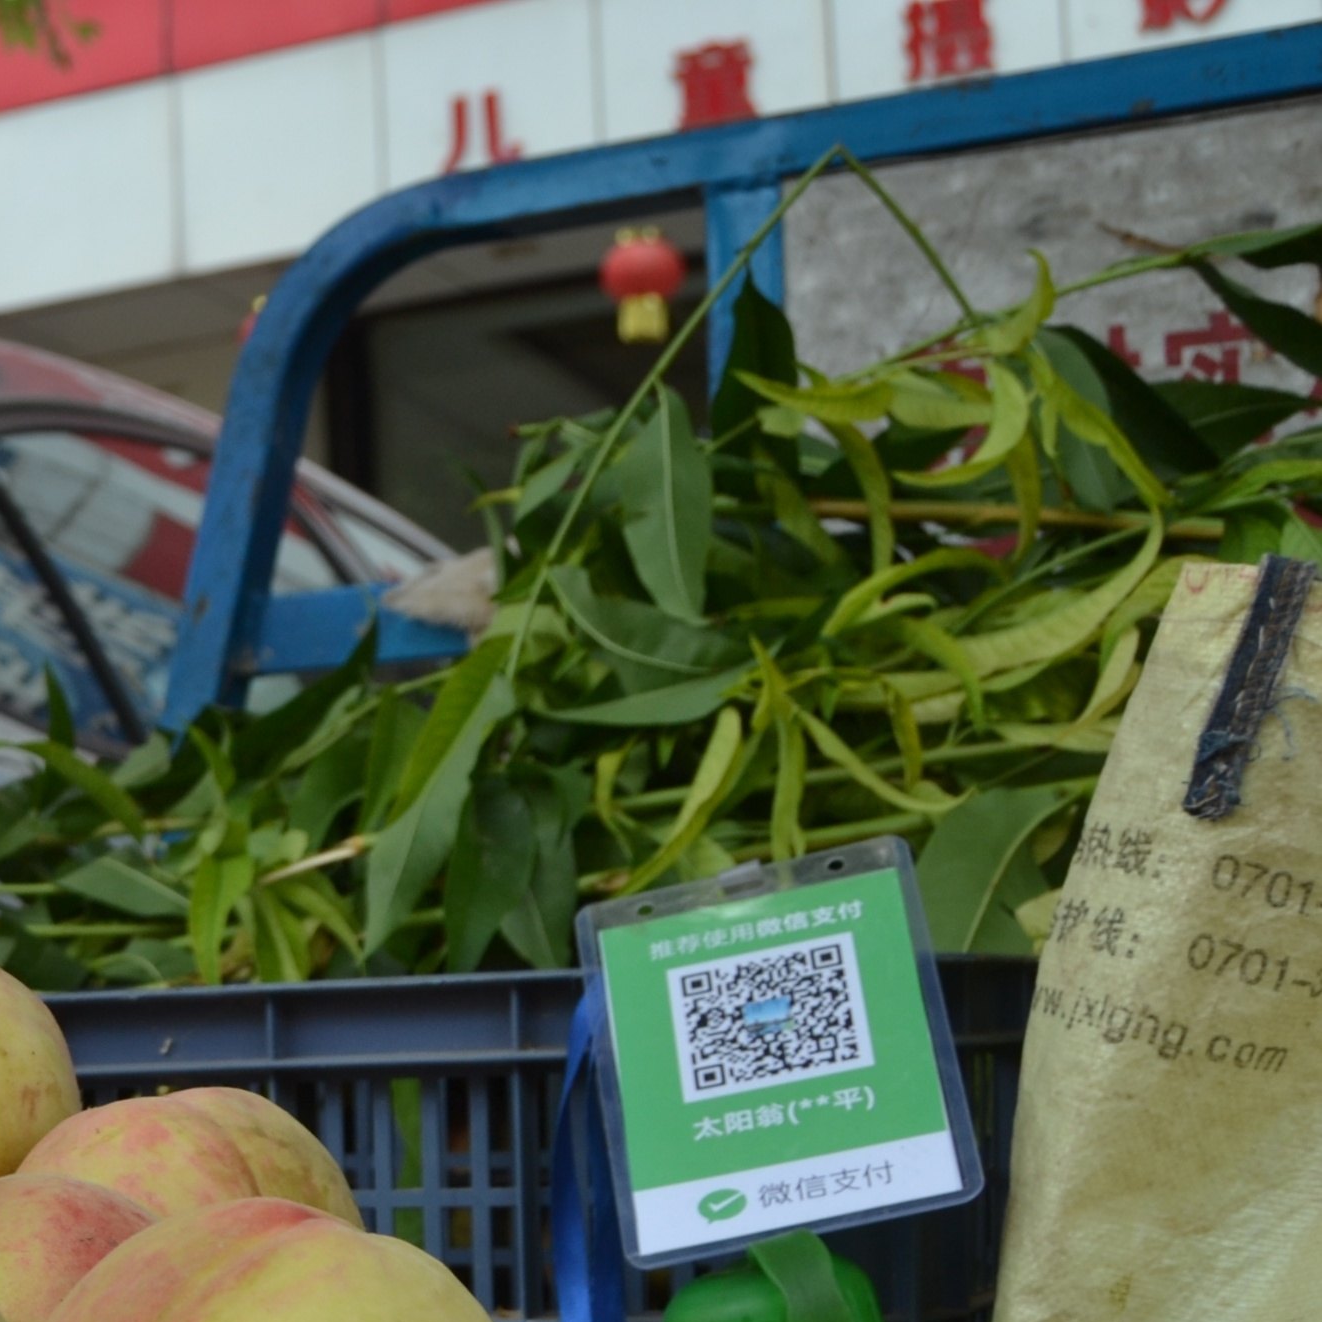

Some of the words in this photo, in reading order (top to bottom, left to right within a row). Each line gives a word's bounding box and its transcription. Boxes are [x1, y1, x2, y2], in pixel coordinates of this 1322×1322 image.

[649, 898, 864, 962] 推荐使用微信支付
[758, 1159, 894, 1208] 微信支付
